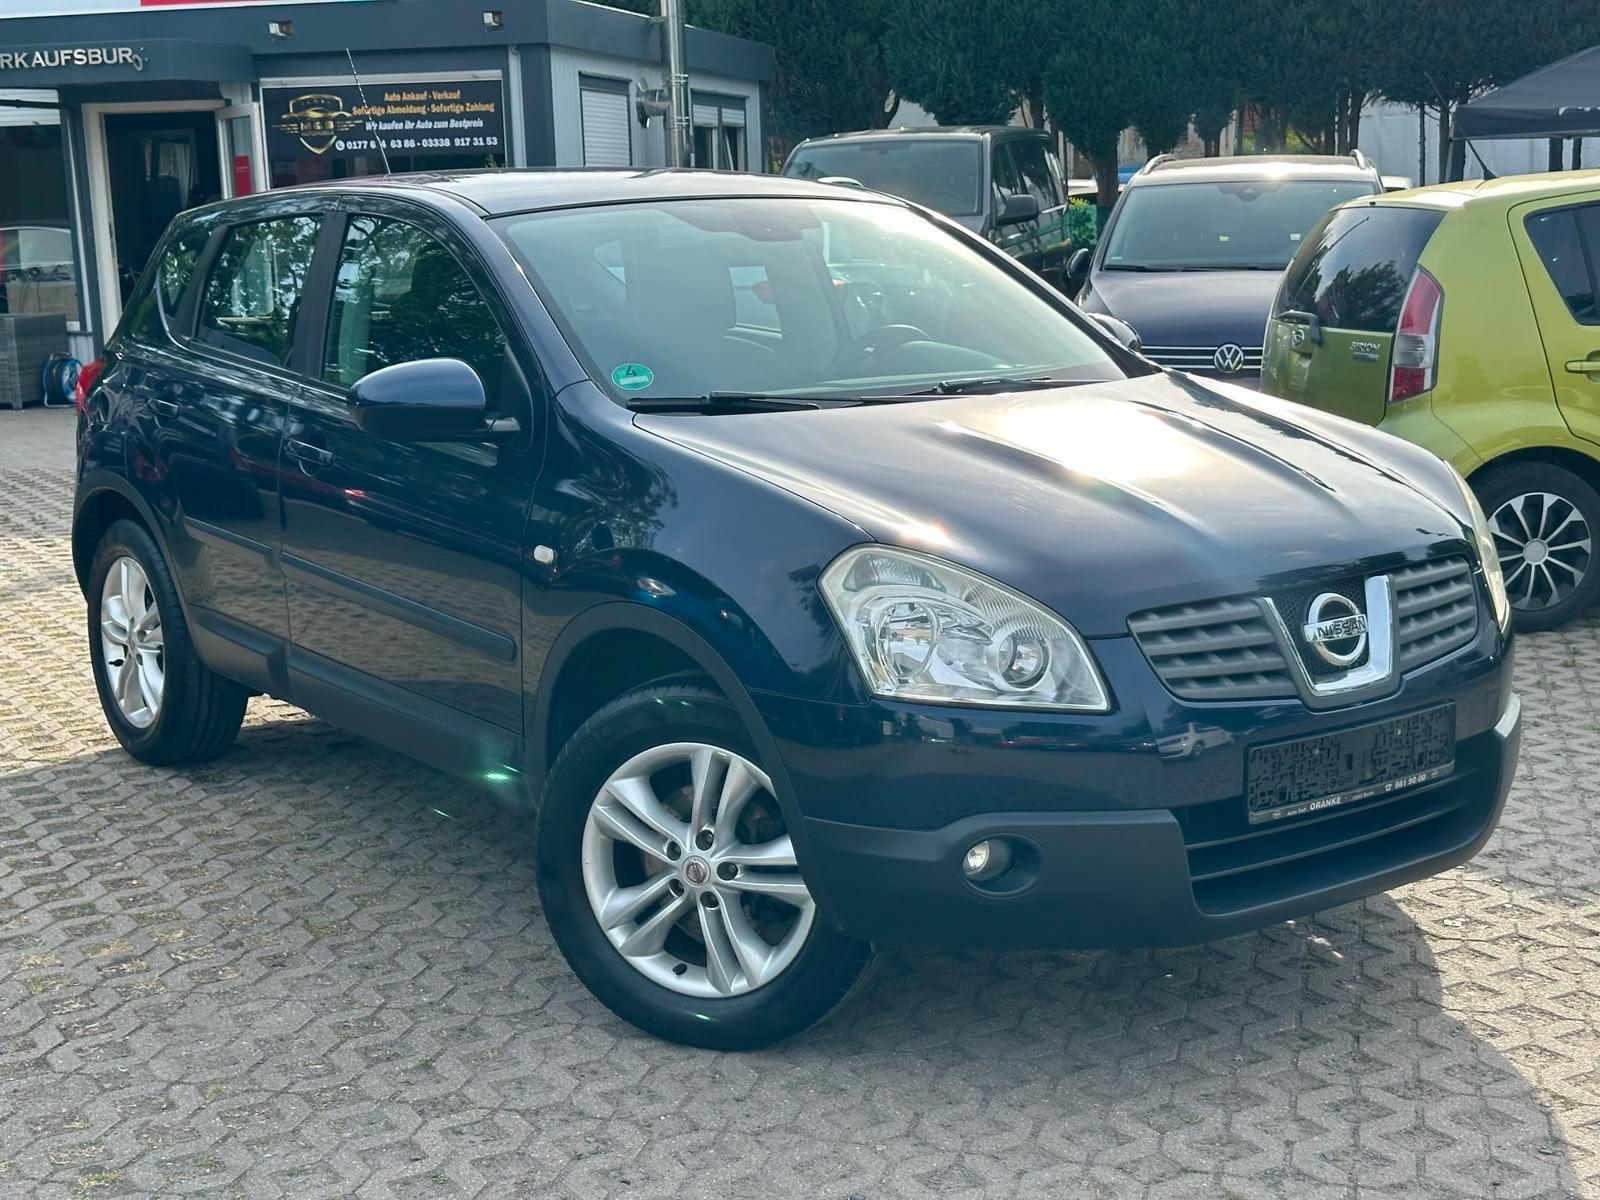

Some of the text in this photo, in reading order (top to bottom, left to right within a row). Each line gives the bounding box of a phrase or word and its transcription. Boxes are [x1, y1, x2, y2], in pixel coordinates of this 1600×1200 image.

[384, 92, 401, 101] Auto
[402, 91, 427, 100] Ankauf
[432, 90, 460, 100] Verkauf
[352, 106, 386, 116] Sofortige
[387, 104, 426, 115] Abmeldung
[431, 103, 464, 114] Sofortige
[465, 102, 495, 113] Zahlung
[379, 121, 403, 130] kaufen
[415, 120, 433, 129] Auto
[433, 121, 449, 129] zum
[449, 118, 484, 130] Bestpreis
[346, 141, 368, 150] 0177
[390, 140, 402, 149] 63
[422, 138, 451, 147] 03338
[454, 137, 471, 147] 917
[473, 137, 485, 146] 31
[486, 136, 498, 146] 53
[626, 365, 638, 377] 4
[1316, 615, 1367, 638] NISSAN
[1309, 796, 1342, 811] ORANKE
